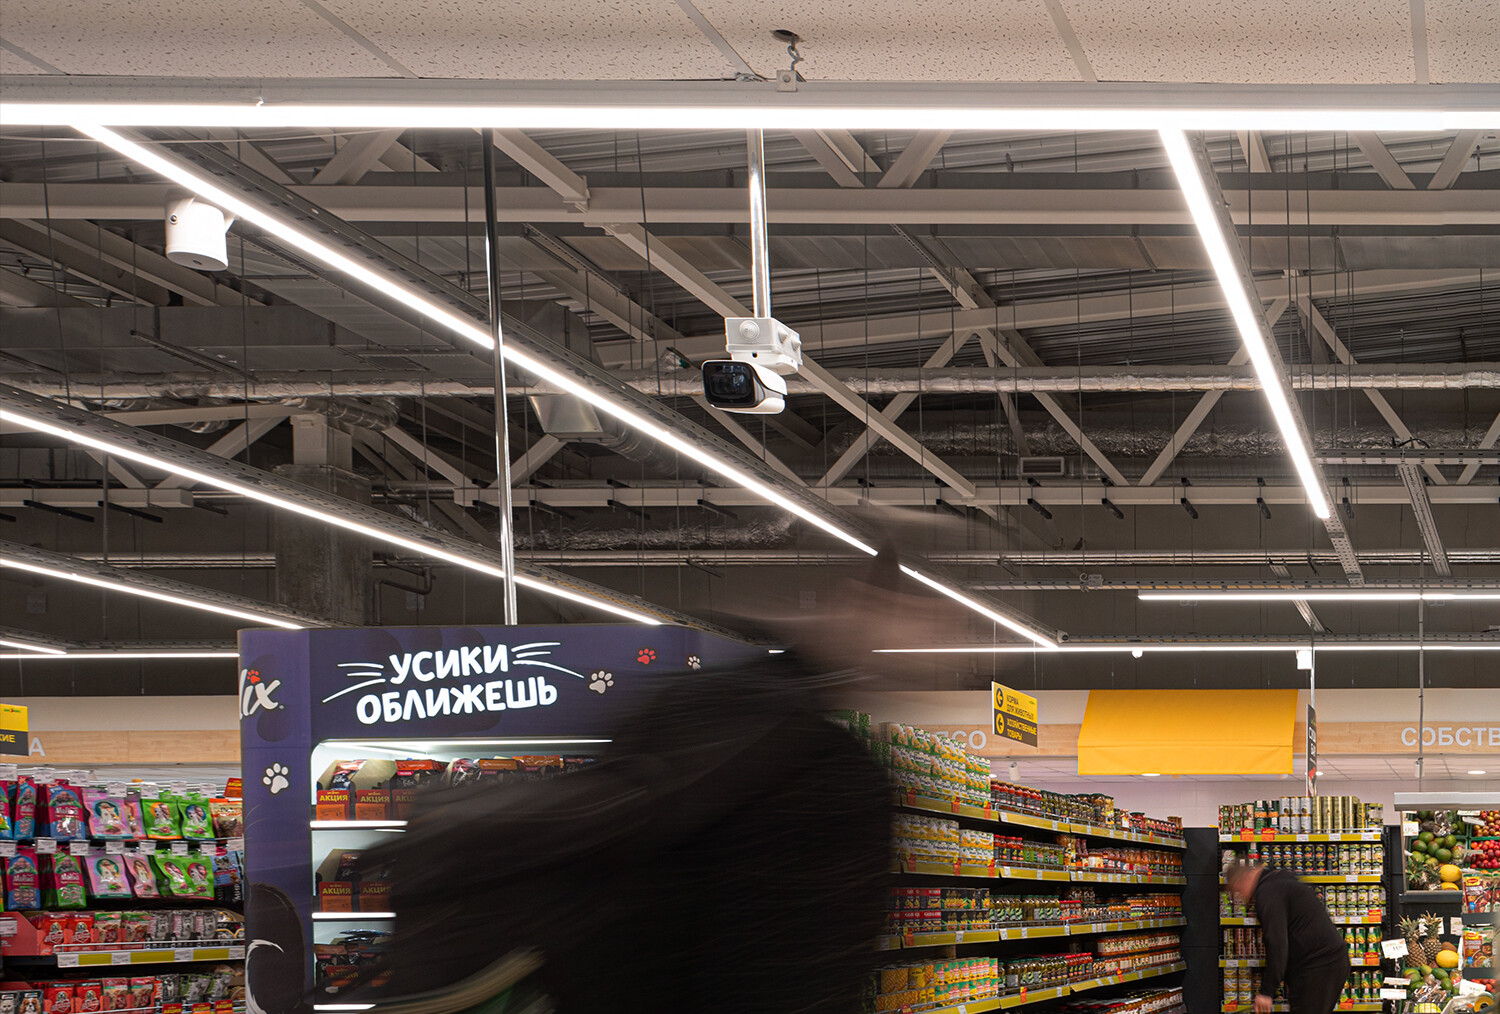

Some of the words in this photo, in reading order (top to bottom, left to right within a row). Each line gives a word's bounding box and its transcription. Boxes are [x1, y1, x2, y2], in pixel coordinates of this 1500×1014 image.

[389, 644, 508, 684] УСИКИ
[356, 676, 558, 725] ОБЛИЖЕШЬ
[319, 794, 349, 803] АКЦИЯ
[360, 795, 390, 803] АКЦИЯ
[322, 887, 351, 895] АКЦИЯ
